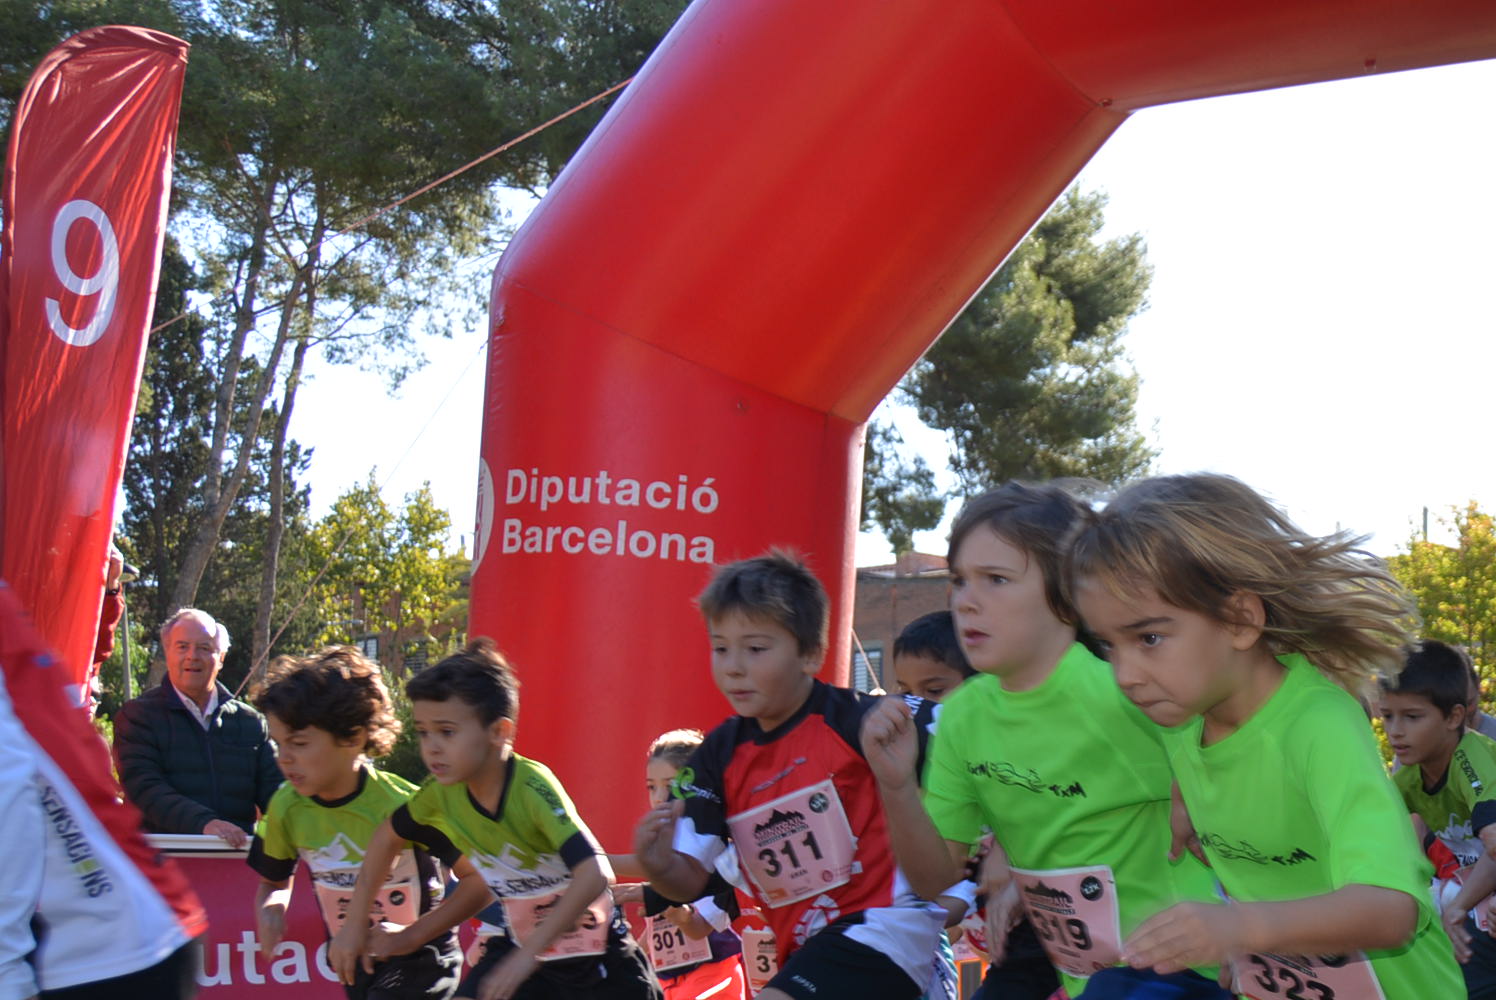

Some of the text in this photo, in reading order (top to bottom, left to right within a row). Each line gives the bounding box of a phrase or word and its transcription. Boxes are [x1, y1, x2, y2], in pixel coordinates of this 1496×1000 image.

[45, 199, 120, 347] 9
[506, 467, 720, 515] Diputació
[503, 518, 715, 564] Barcelona
[758, 831, 823, 878] 311
[652, 928, 686, 952] 301
[1032, 910, 1093, 951] 319
